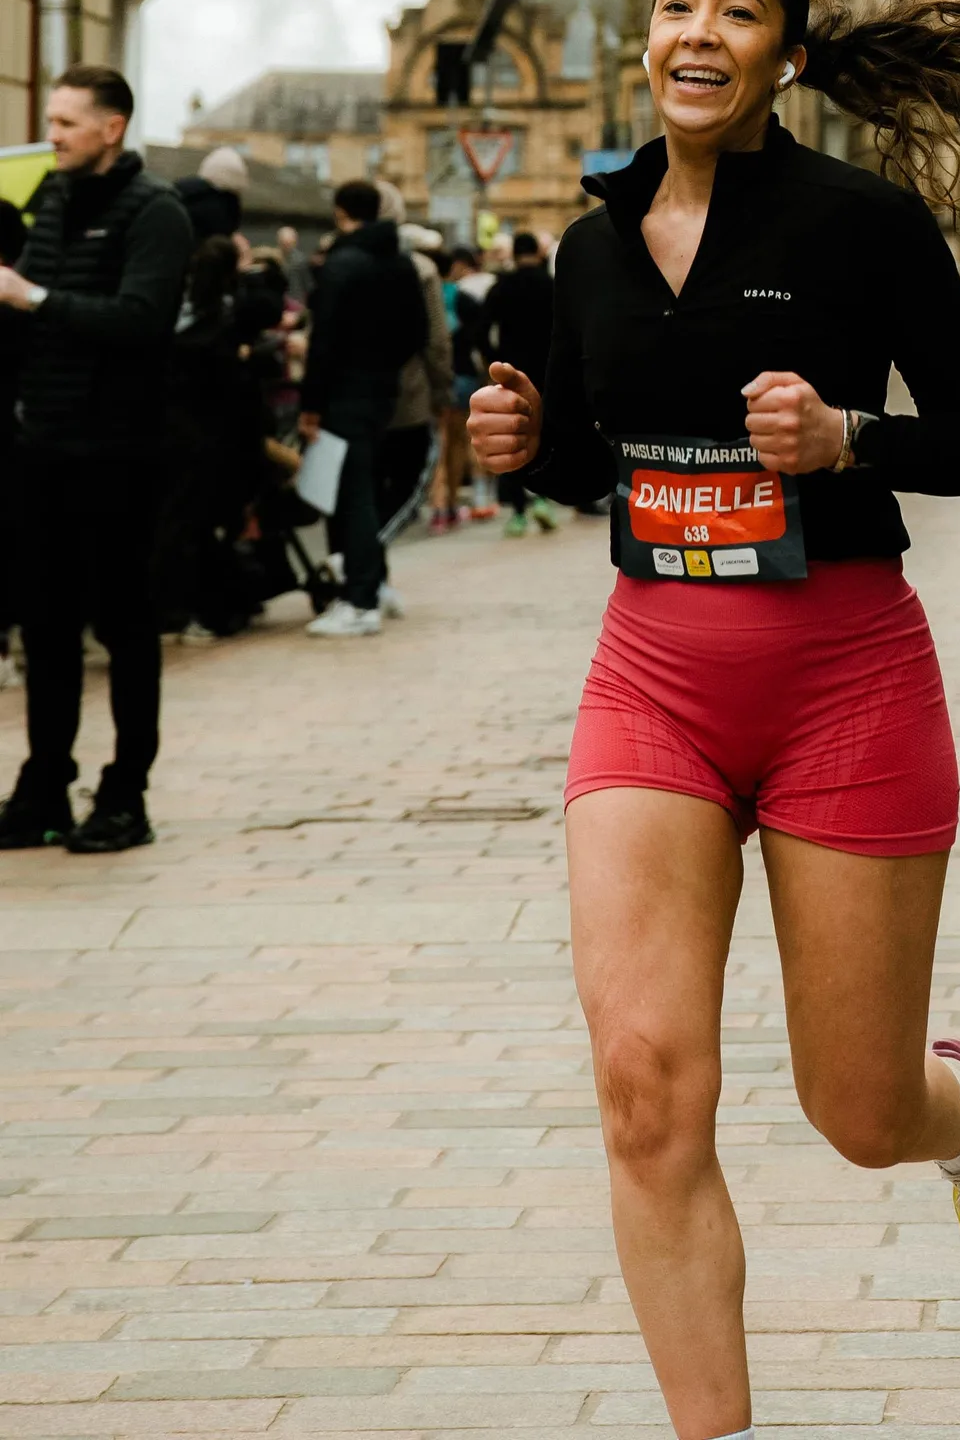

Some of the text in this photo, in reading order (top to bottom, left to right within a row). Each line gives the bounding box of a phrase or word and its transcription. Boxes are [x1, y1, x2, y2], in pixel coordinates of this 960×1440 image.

[744, 289, 792, 300] USAPRO
[622, 442, 759, 464] PAISLEY HALF MARATH
[635, 481, 773, 514] DANIELLE
[684, 525, 710, 542] 638
